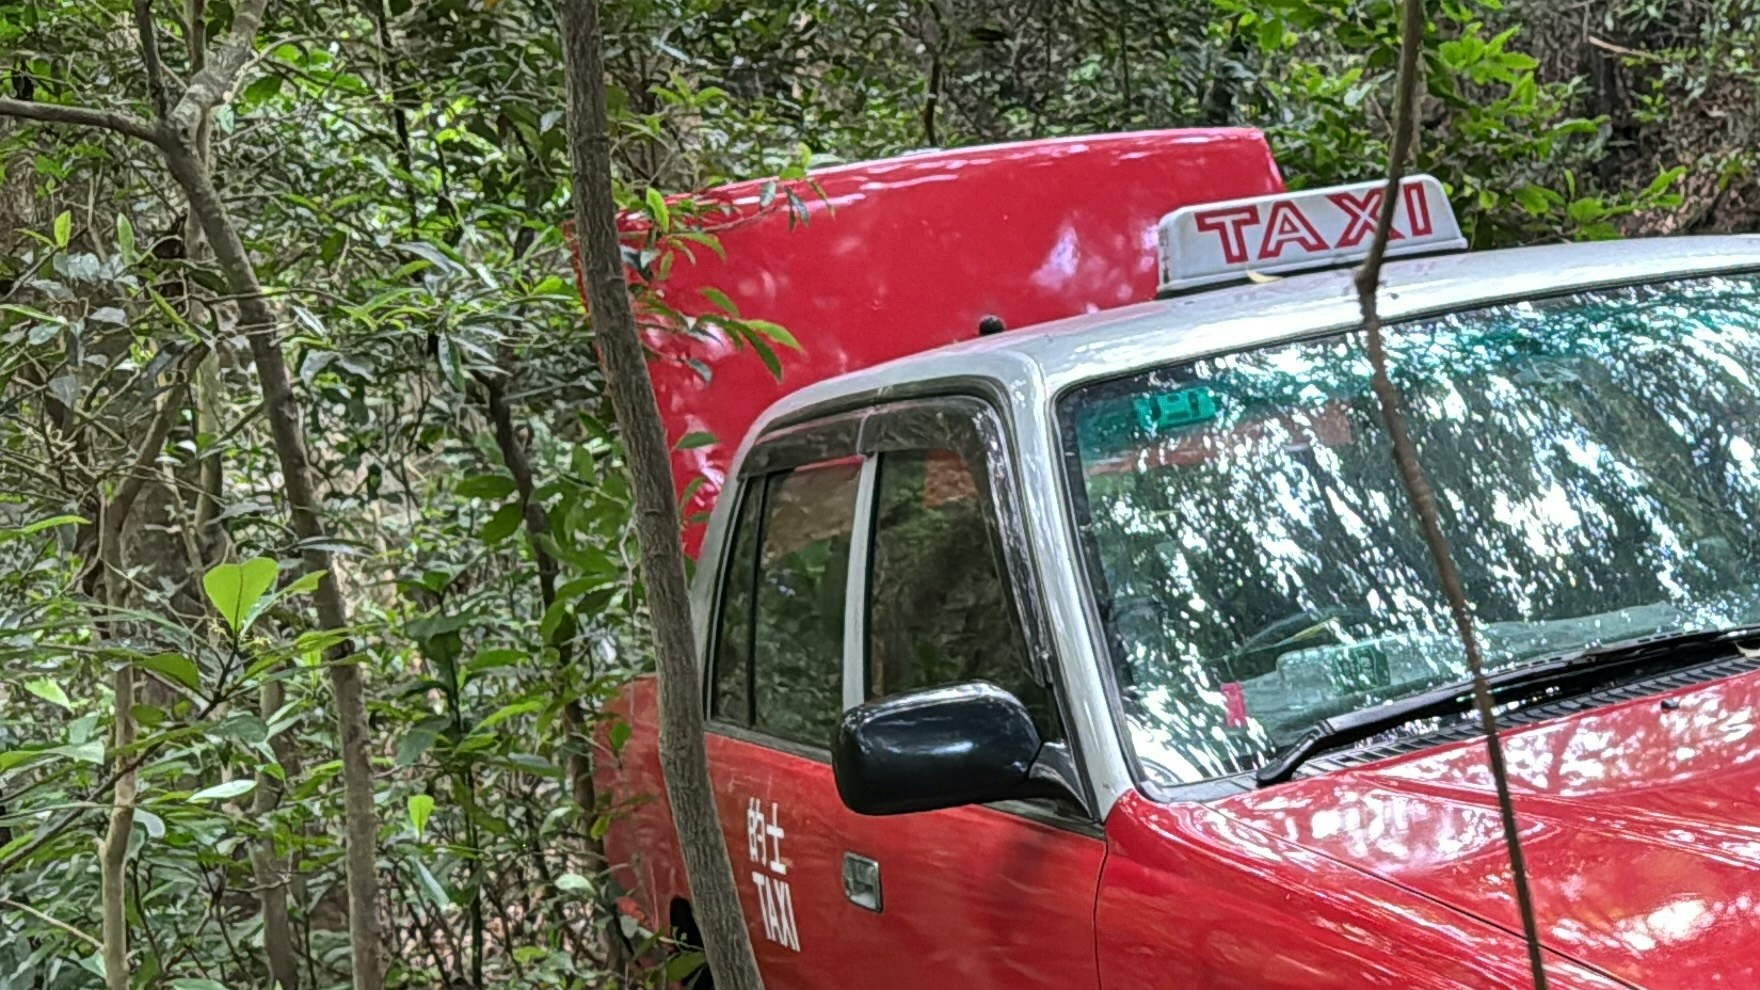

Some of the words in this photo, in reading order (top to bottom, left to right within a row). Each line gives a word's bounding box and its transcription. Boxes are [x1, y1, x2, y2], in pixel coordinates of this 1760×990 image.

[1193, 181, 1433, 264] TAXI
[748, 797, 787, 875] 的士
[752, 871, 801, 953] TAXI
